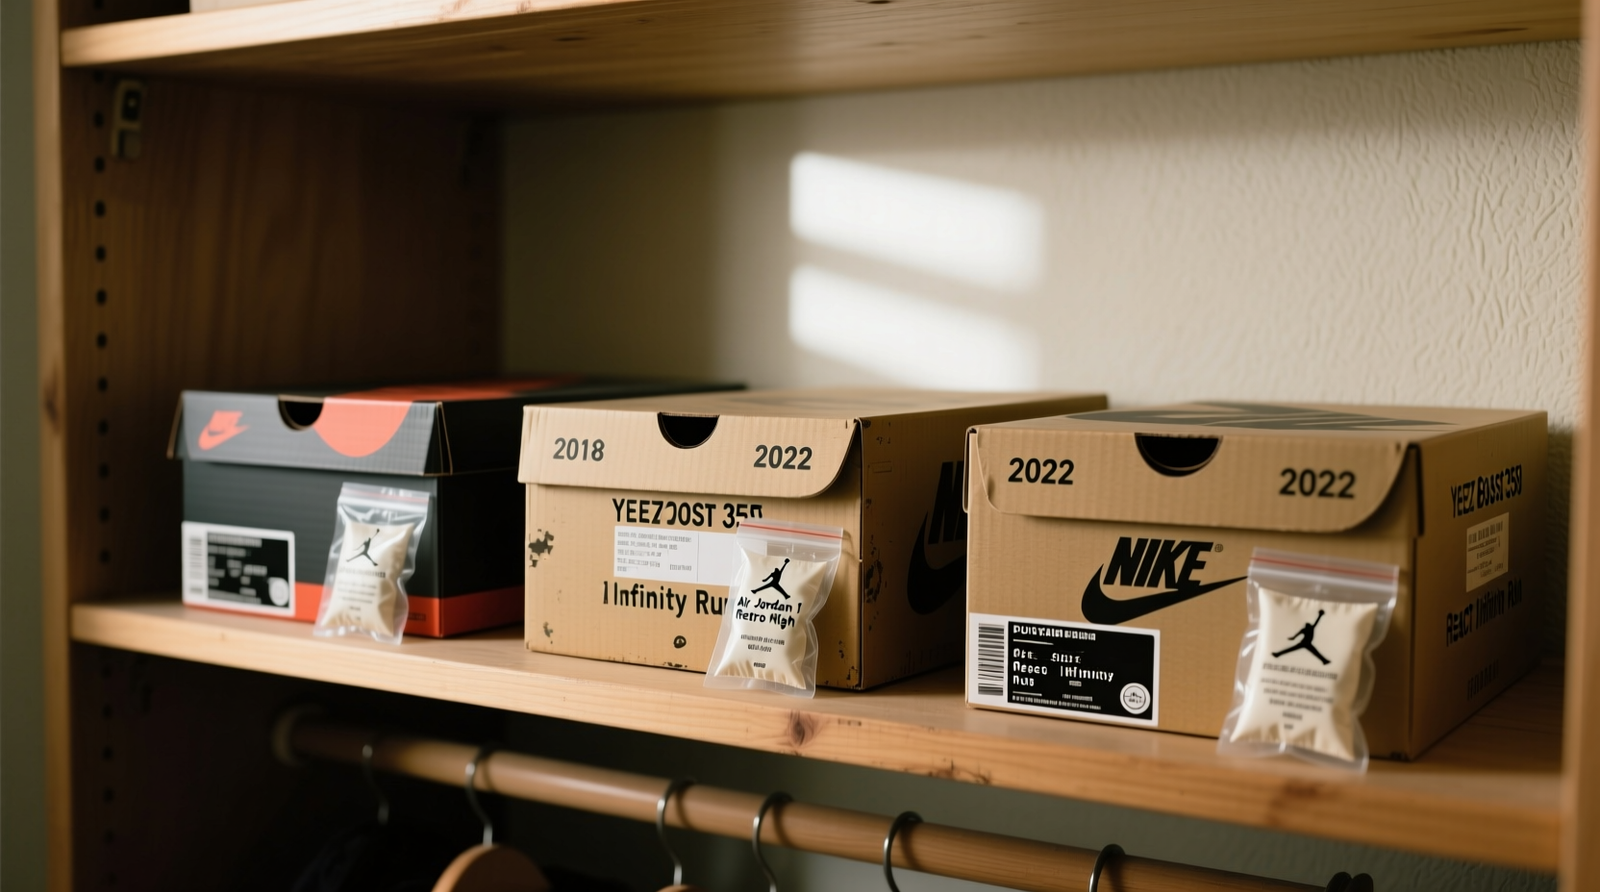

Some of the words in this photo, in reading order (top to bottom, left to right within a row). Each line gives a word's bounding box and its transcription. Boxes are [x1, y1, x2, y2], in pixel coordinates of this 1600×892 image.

[552, 437, 605, 462] 2018
[753, 444, 813, 471] 2022
[1007, 457, 1075, 485] 2022
[1278, 468, 1357, 499] 2022
[1103, 536, 1214, 590] NIKE
[614, 582, 687, 618] Infinity
[754, 597, 793, 613] Jordan
